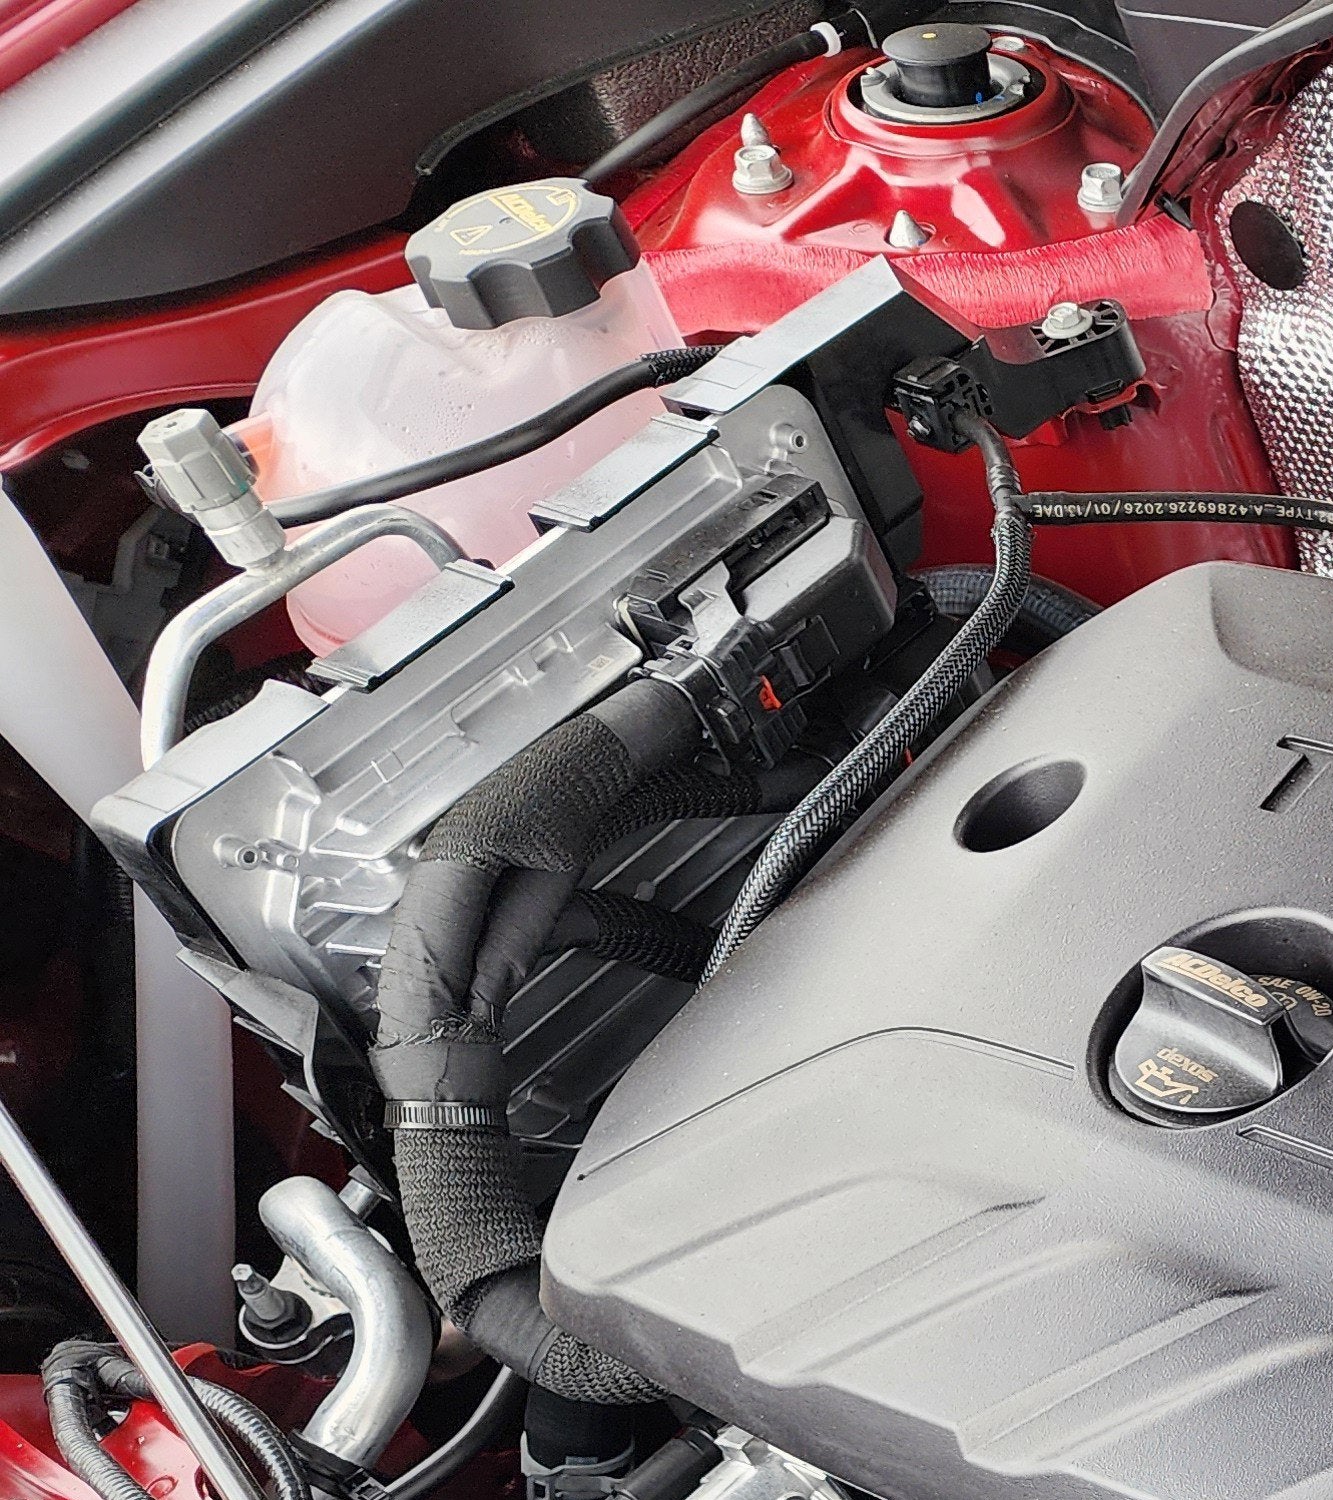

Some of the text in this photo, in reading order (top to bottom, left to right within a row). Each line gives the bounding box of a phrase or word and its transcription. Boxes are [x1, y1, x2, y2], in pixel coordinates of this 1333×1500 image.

[1159, 953, 1269, 1009] ACDelco
[1257, 975, 1333, 1018] SAE 0W-20
[1156, 1048, 1219, 1084] dexos
